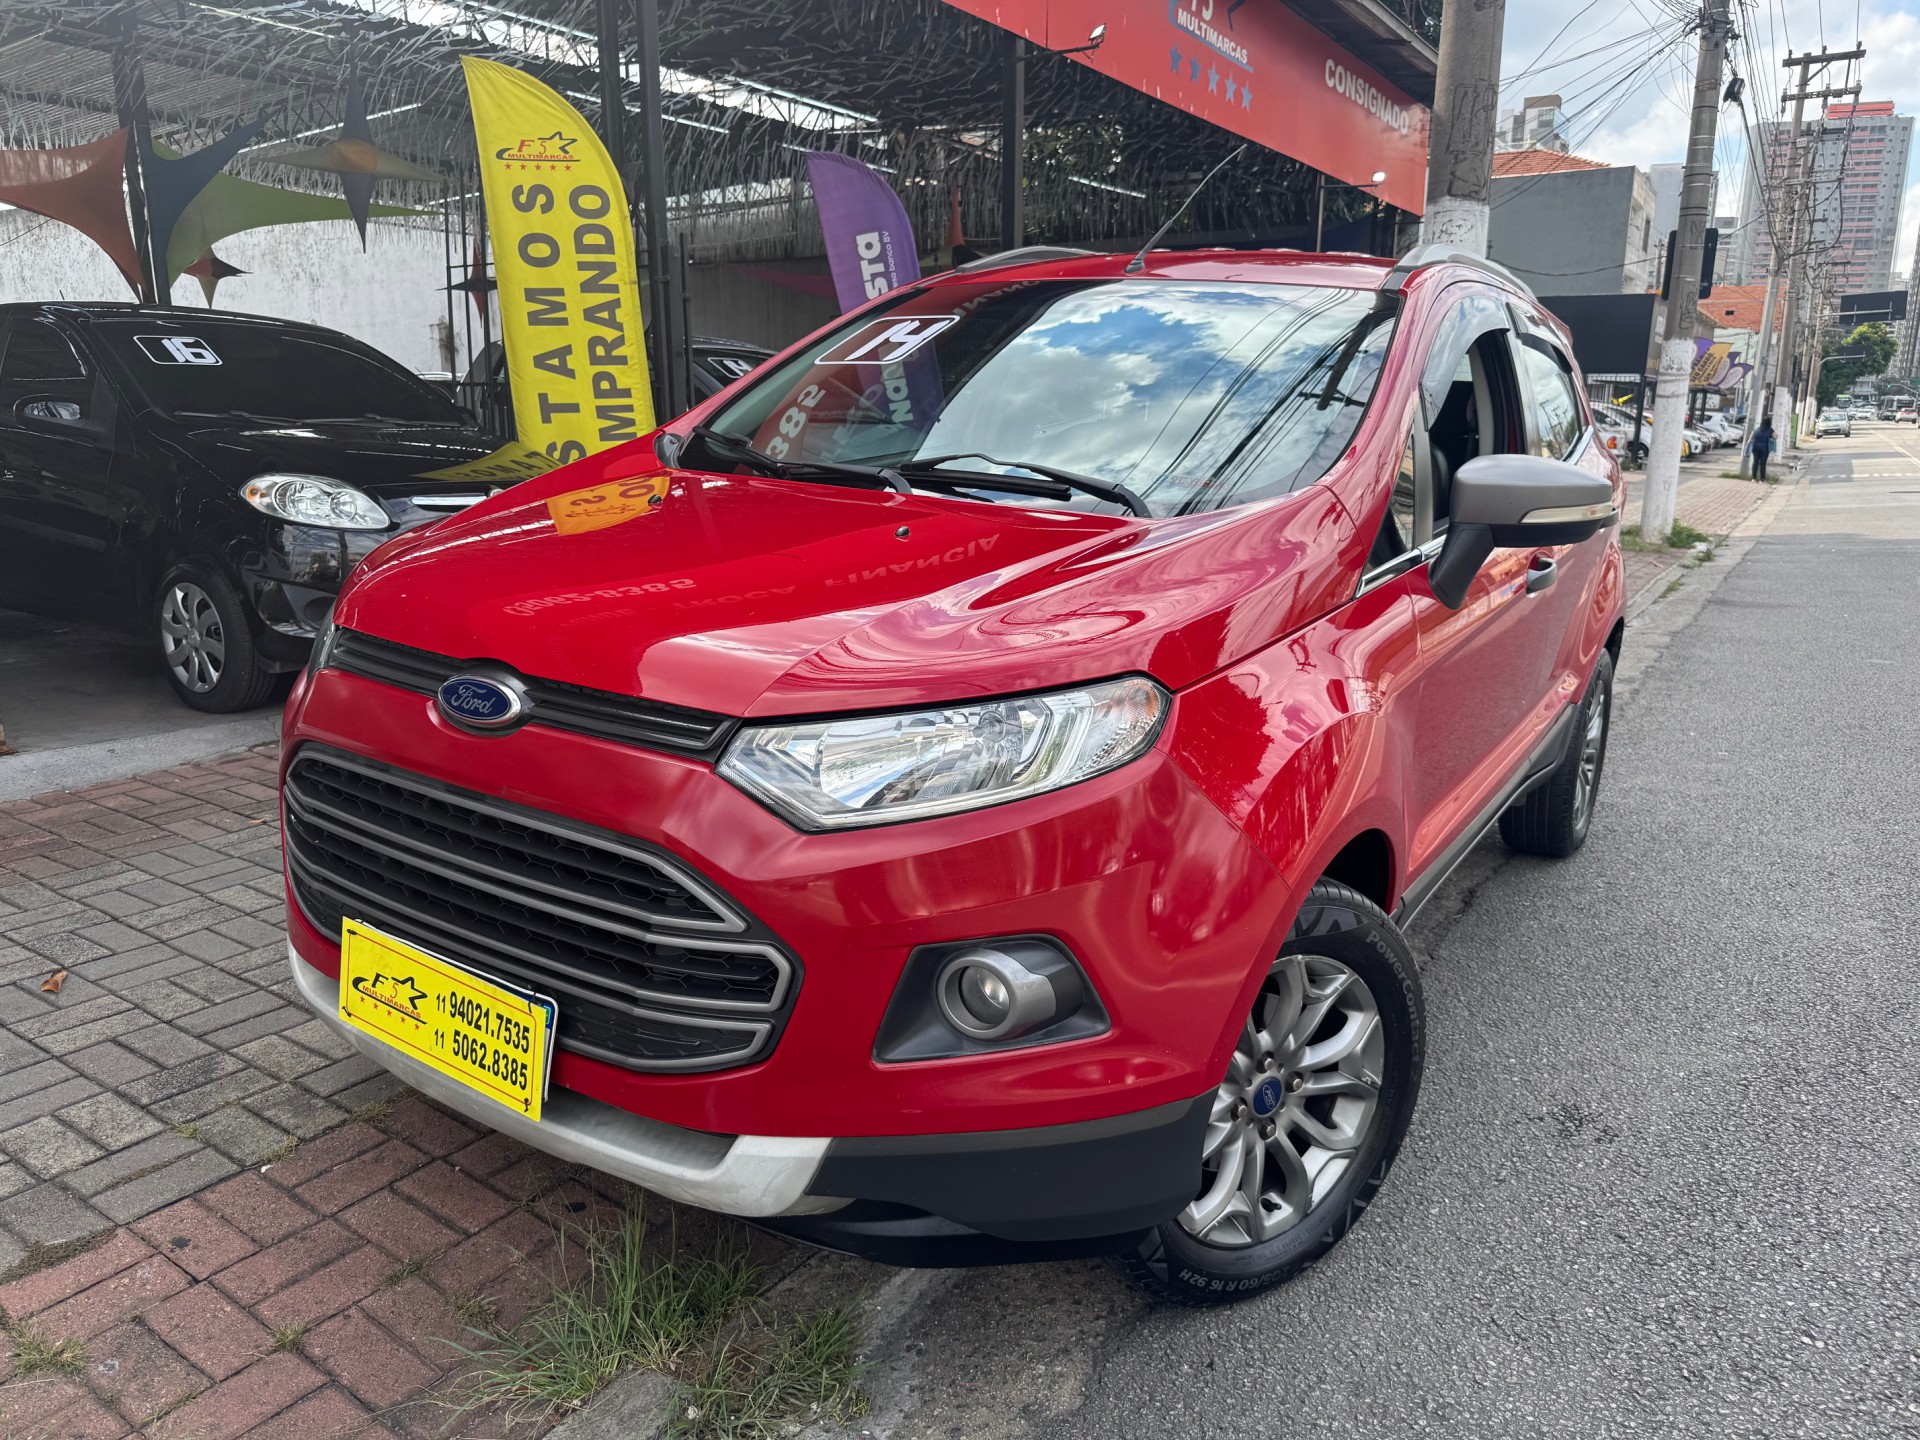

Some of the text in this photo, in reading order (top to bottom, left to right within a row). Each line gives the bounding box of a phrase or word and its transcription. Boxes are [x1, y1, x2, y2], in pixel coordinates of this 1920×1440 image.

[1177, 8, 1248, 64] MULTIMARCAS
[1324, 58, 1409, 135] CONSIGNADO
[507, 153, 575, 161] MULTIMARCAS
[881, 230, 891, 243] BV
[511, 183, 588, 465] STAMOS
[568, 184, 638, 443] MPRANDO
[160, 338, 217, 364] 16
[843, 319, 951, 361] 14
[451, 684, 497, 714] Ford
[362, 985, 422, 1020] MULTIMARCAS
[436, 991, 531, 1055] 11 94021.7535
[434, 1028, 529, 1091] 11 5062.8385
